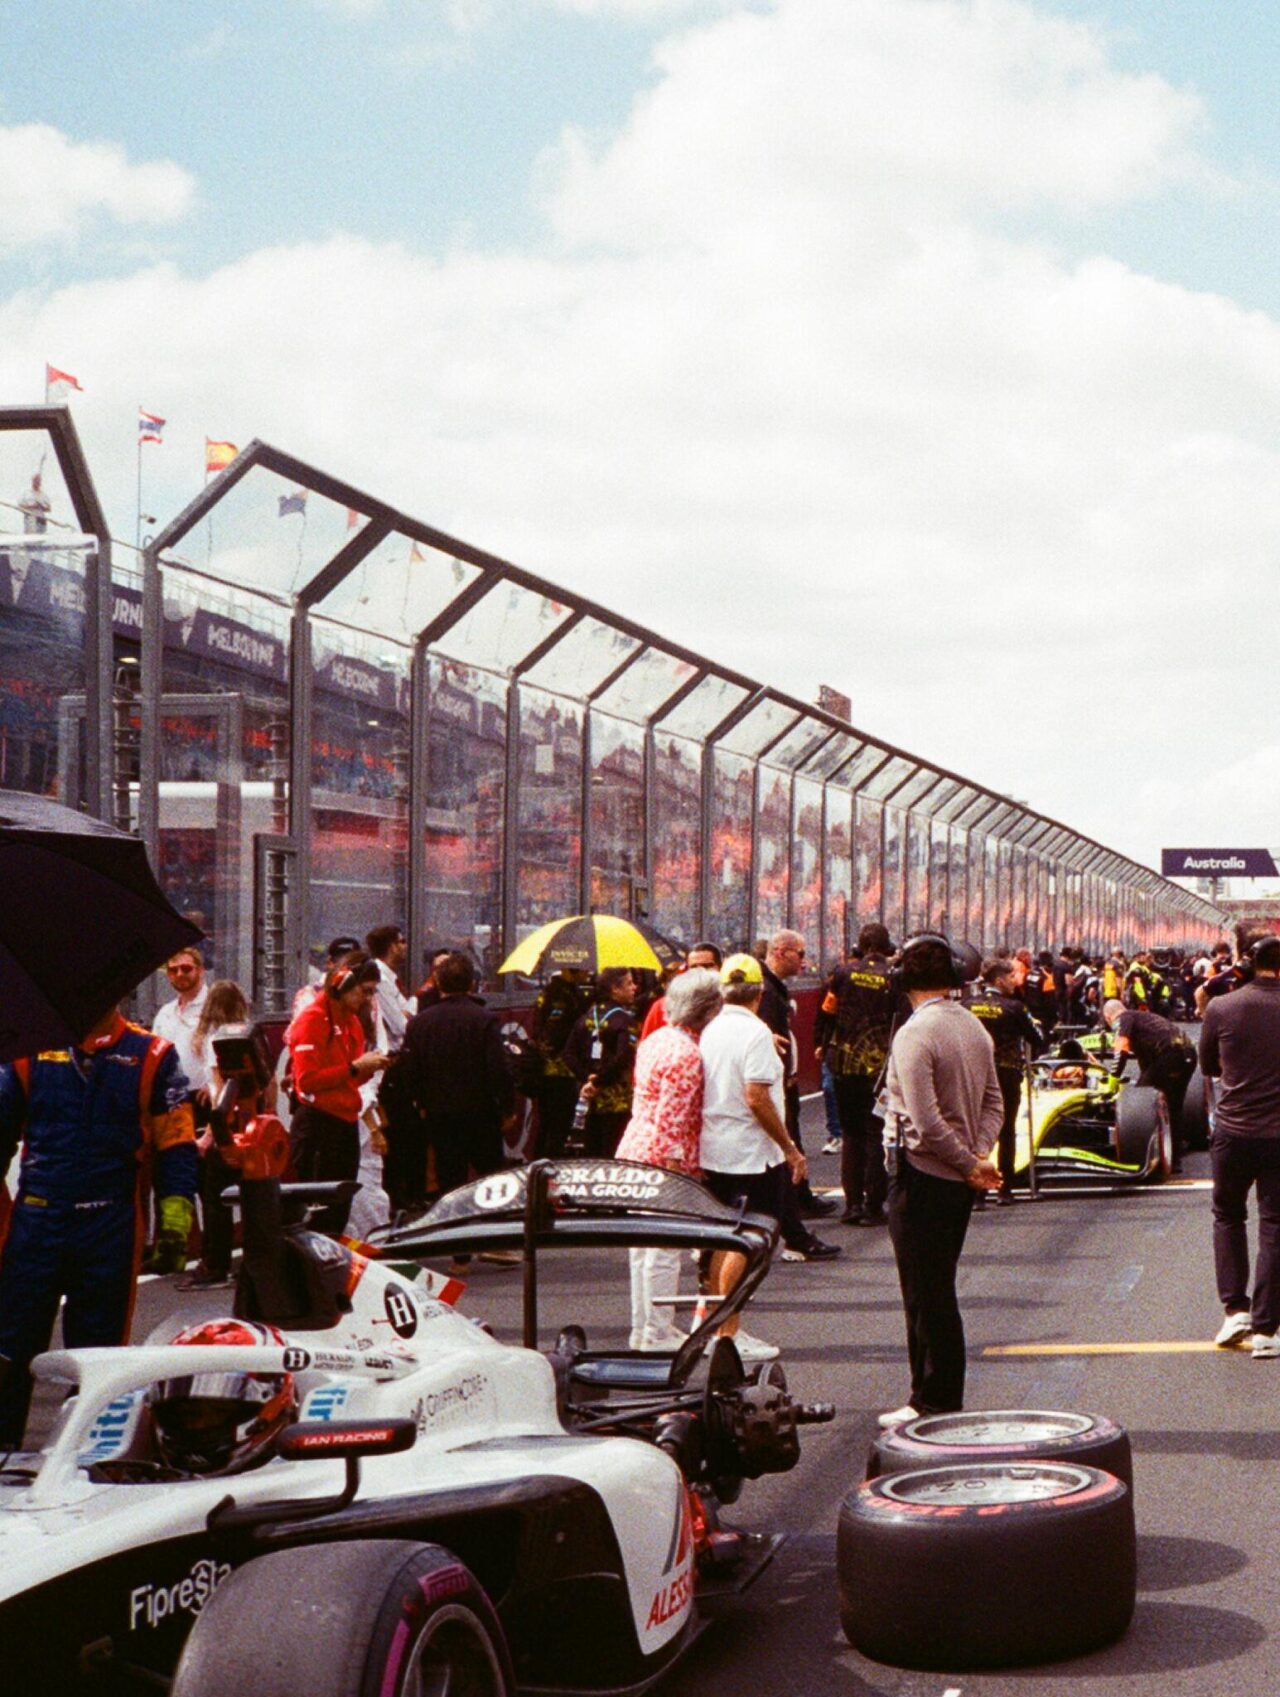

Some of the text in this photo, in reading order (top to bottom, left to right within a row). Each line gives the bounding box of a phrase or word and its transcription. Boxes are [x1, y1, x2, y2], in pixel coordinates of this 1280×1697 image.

[1183, 857, 1246, 869] Australia
[592, 1184, 660, 1199] GROUP
[333, 1431, 388, 1443] RACING
